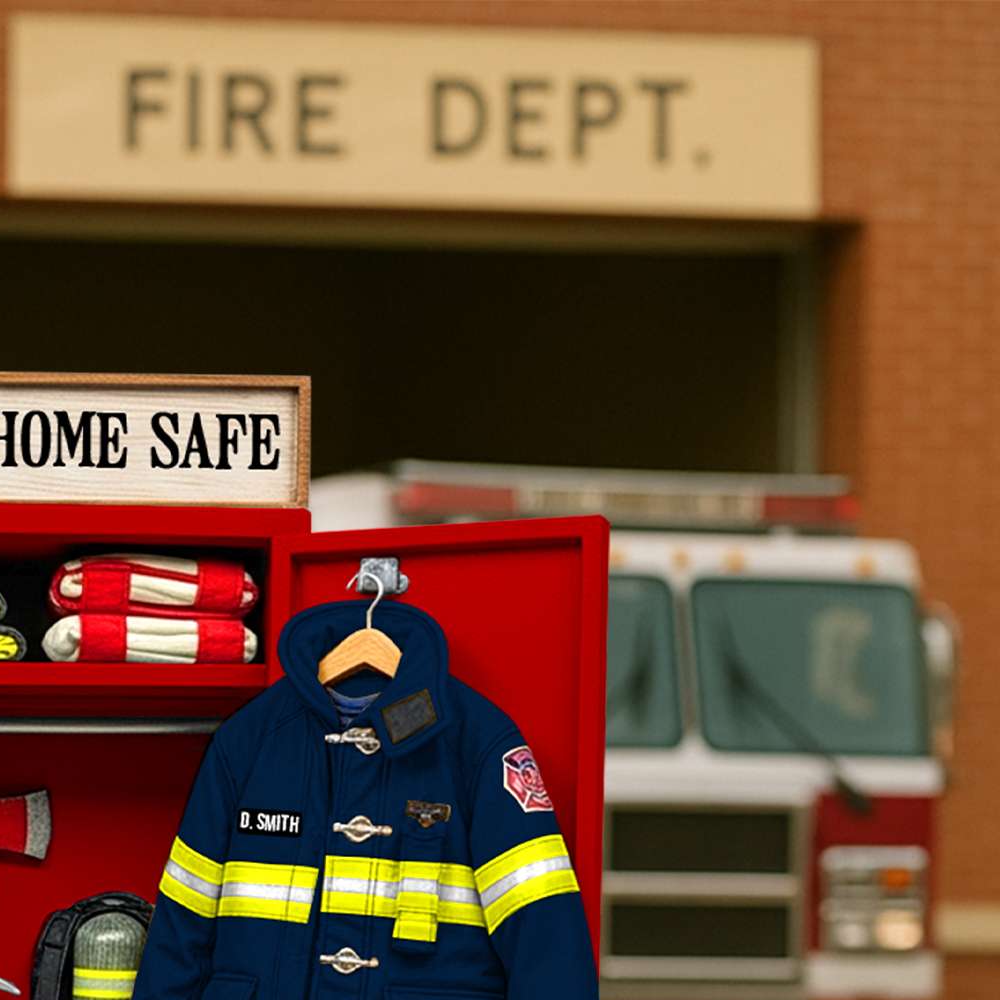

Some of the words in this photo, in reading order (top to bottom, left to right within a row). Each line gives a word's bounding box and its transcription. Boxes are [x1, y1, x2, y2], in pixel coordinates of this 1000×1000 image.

[122, 65, 348, 160] FIRE
[427, 74, 712, 171] DEPT.
[150, 412, 281, 470] SAFE
[240, 811, 253, 830] D.
[256, 812, 299, 833] SMITH
